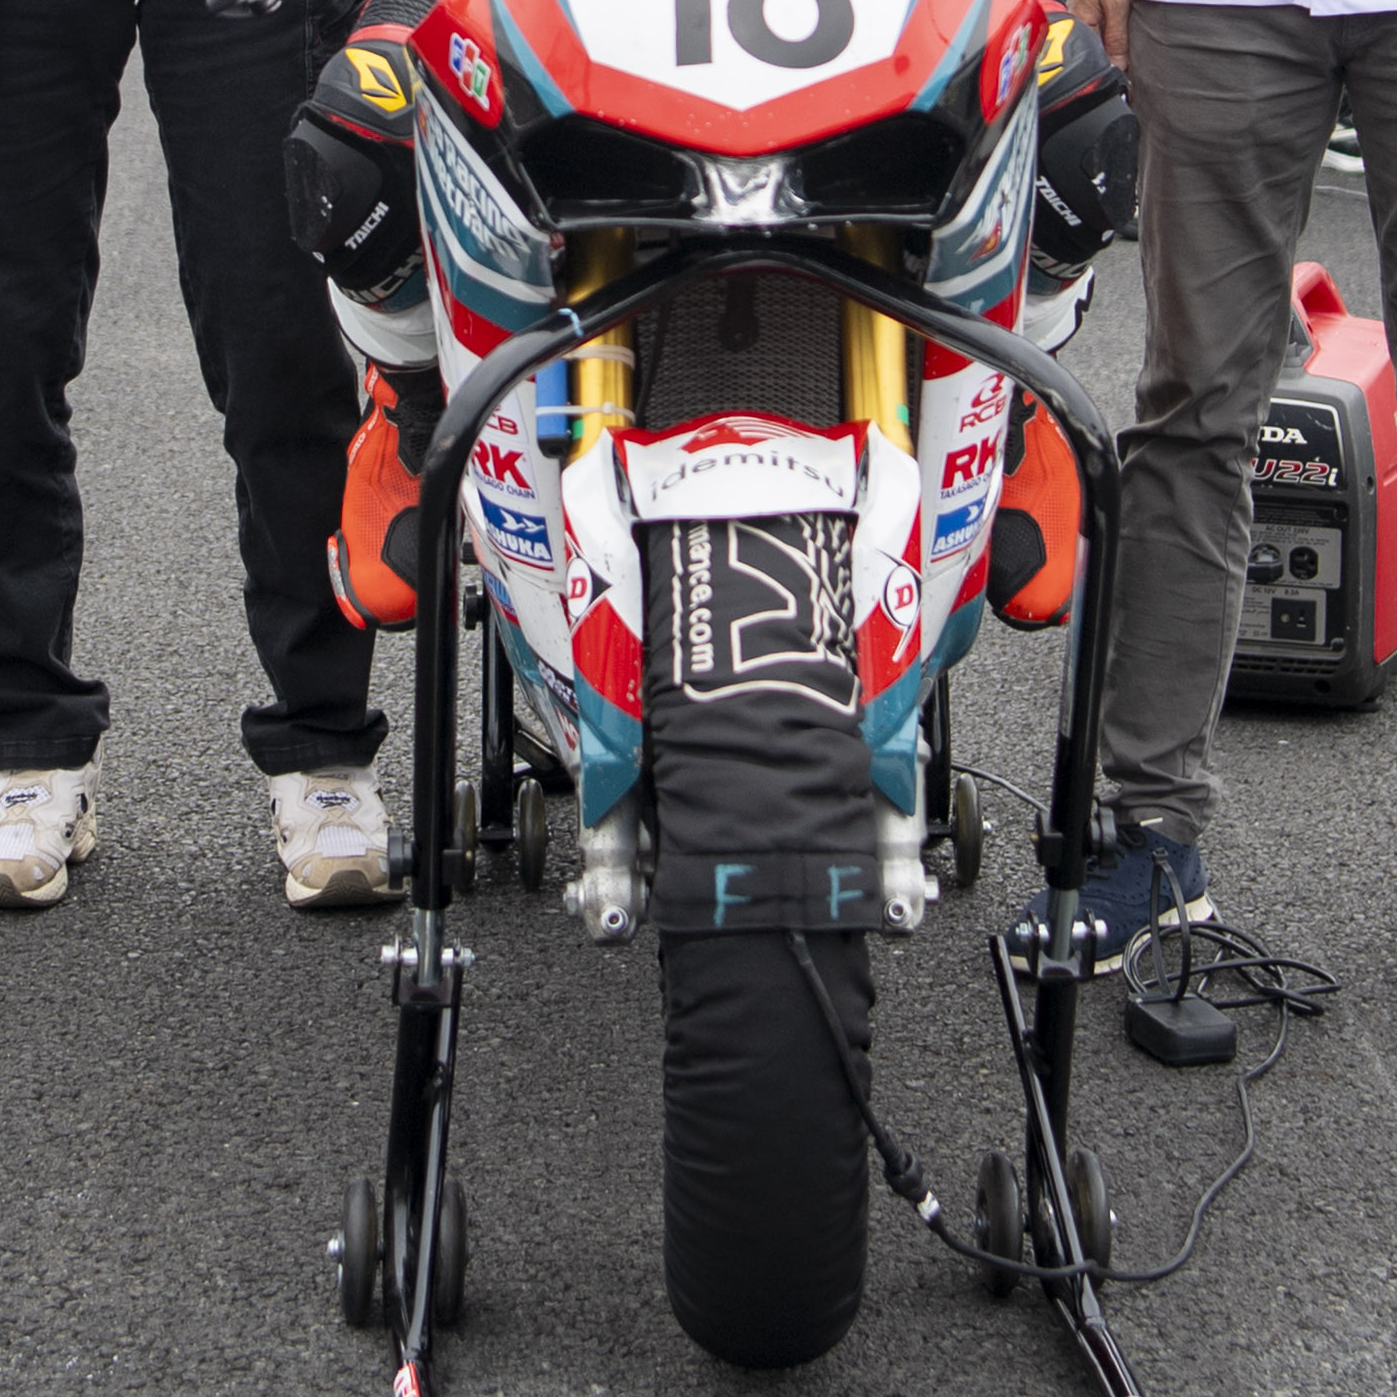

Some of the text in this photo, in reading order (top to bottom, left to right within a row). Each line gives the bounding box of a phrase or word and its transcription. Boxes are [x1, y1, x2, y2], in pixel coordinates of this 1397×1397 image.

[345, 201, 390, 250] TAICHI
[1037, 177, 1082, 227] TAICHI
[471, 439, 532, 490] RK
[651, 451, 845, 502] idemitsu
[1252, 457, 1339, 487] U22i
[714, 864, 864, 927] F F
